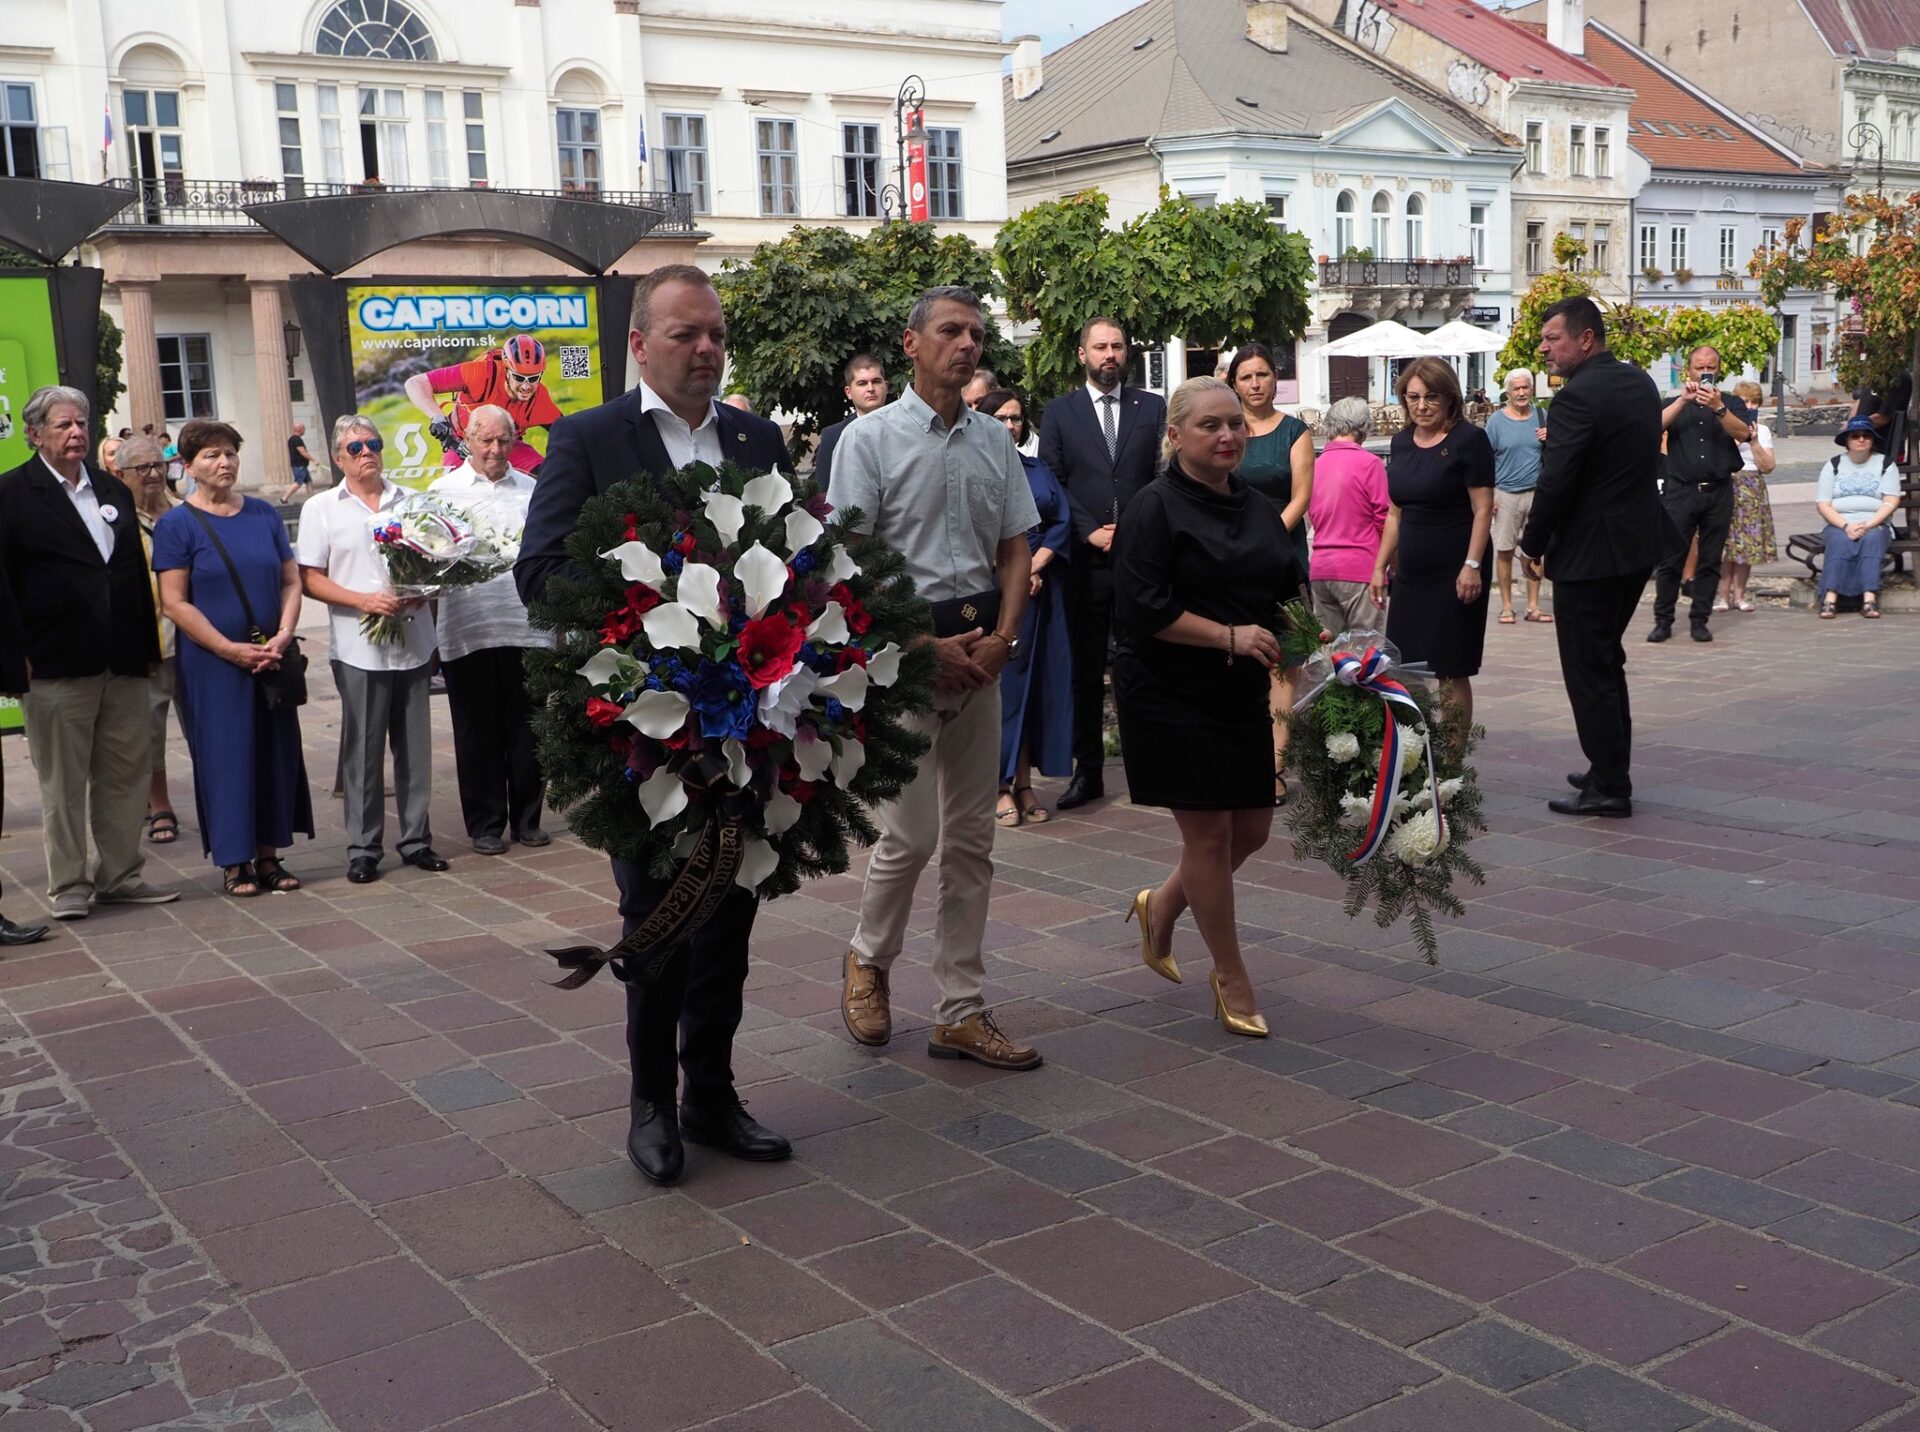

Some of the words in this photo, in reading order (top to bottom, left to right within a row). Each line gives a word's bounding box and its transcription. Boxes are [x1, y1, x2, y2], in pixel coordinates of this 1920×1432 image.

[1716, 279, 1744, 290] HOTEL
[360, 295, 588, 331] CAPRICORN
[361, 334, 497, 350] www.capricorn.sk
